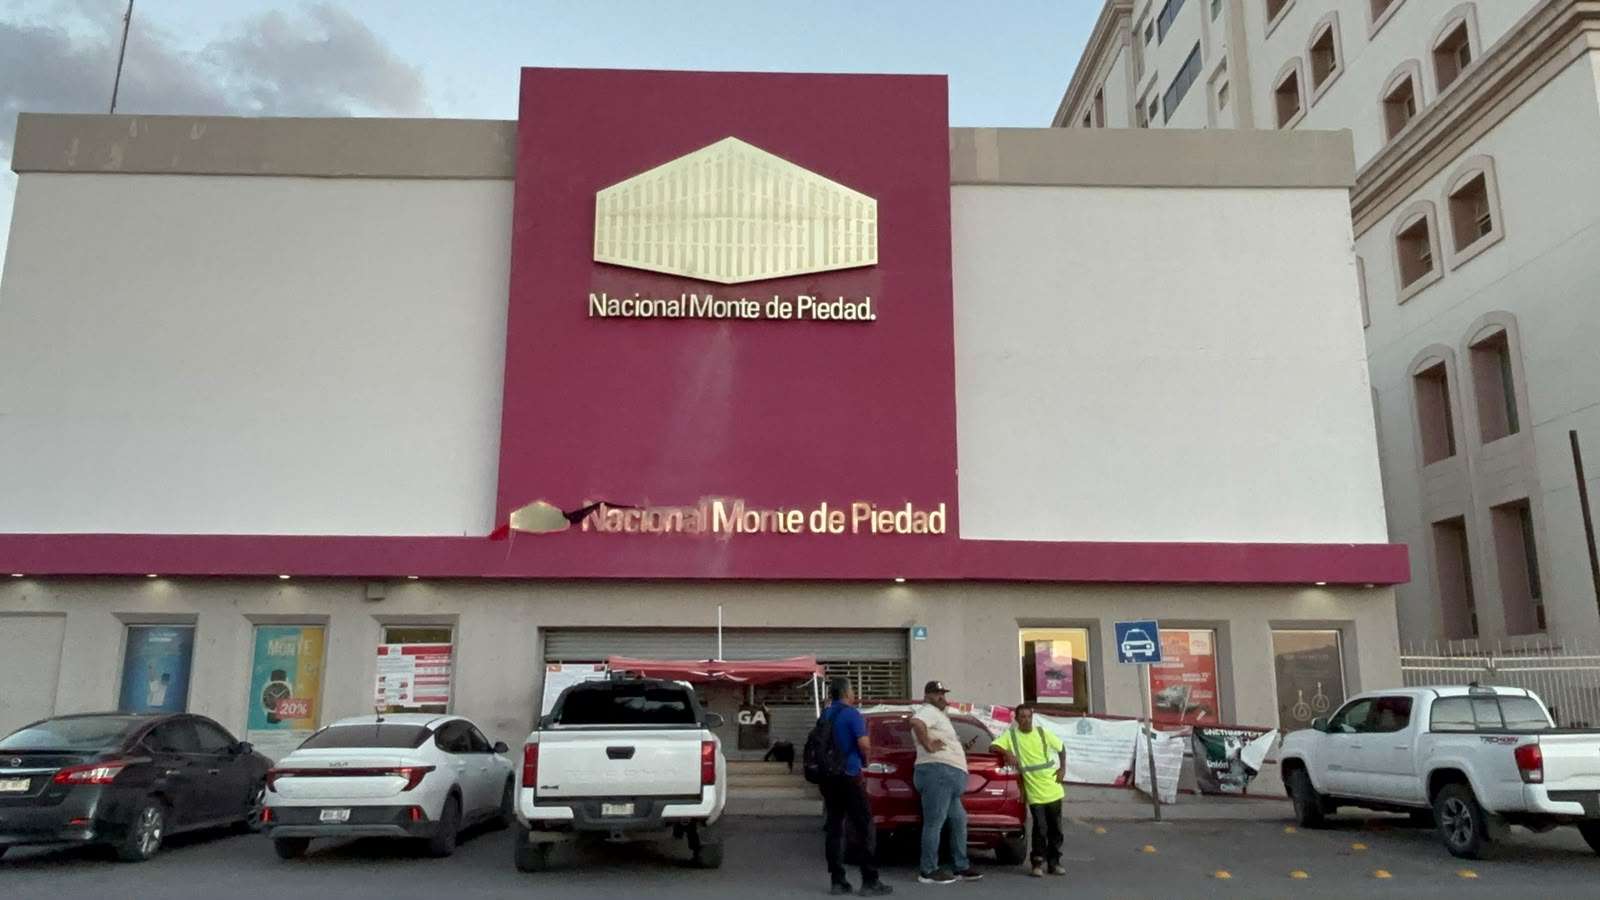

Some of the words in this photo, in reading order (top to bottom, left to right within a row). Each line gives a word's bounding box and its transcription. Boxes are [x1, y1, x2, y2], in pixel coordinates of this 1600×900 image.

[588, 292, 686, 317] Nacional
[689, 294, 760, 319] Monte
[765, 295, 792, 319] de
[797, 295, 877, 321] Piedad.
[581, 501, 707, 533] Nacional
[712, 500, 804, 533] Monte
[809, 502, 845, 534] de
[852, 502, 946, 534] Piedad
[738, 710, 768, 725] GA
